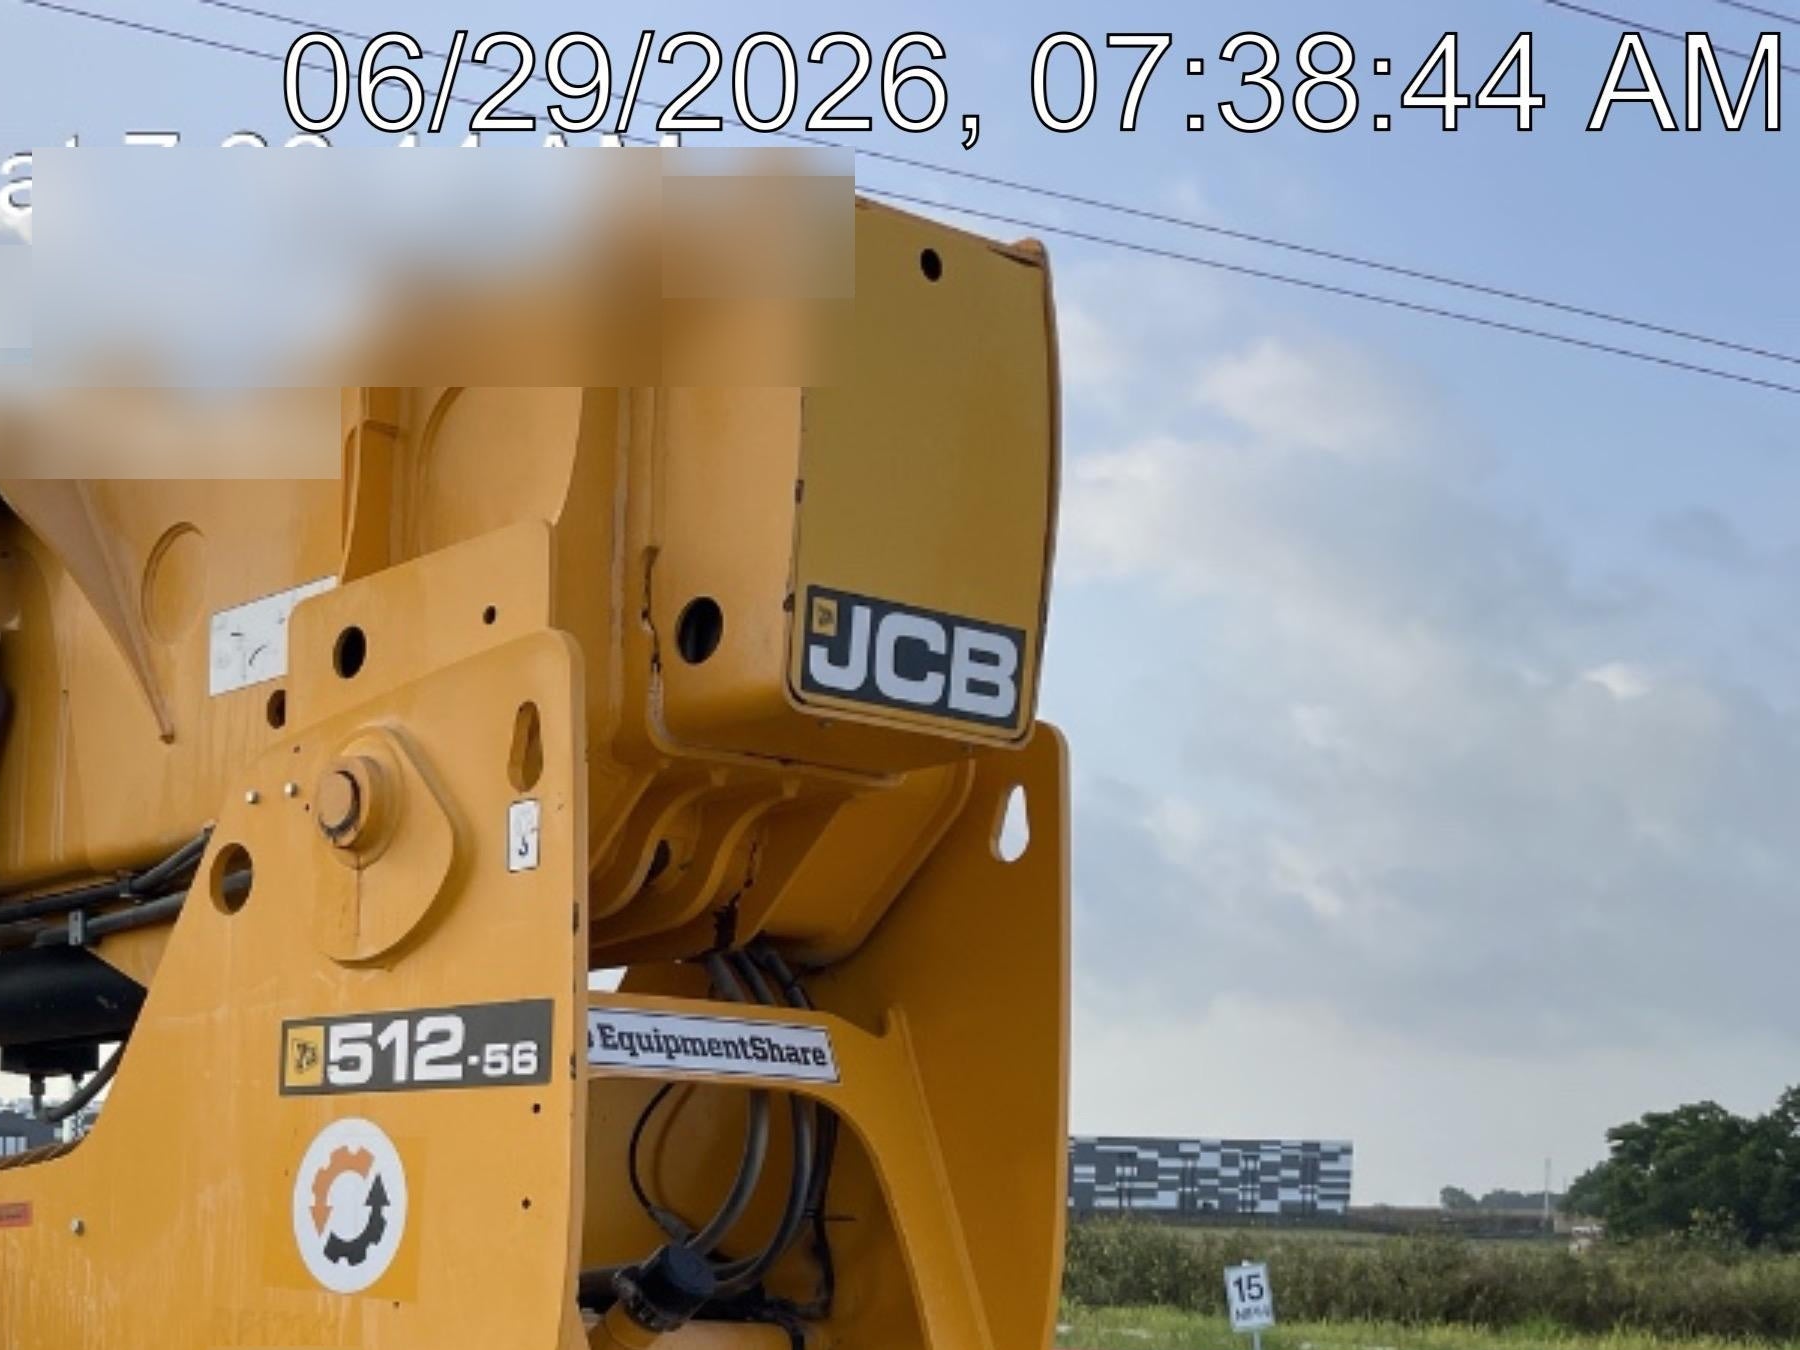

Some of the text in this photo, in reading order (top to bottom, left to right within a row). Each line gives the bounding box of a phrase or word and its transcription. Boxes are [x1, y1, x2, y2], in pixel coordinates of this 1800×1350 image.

[808, 604, 1018, 718] JCB
[597, 1023, 828, 1066] EquipmentShare
[1233, 1273, 1265, 1303] 15
